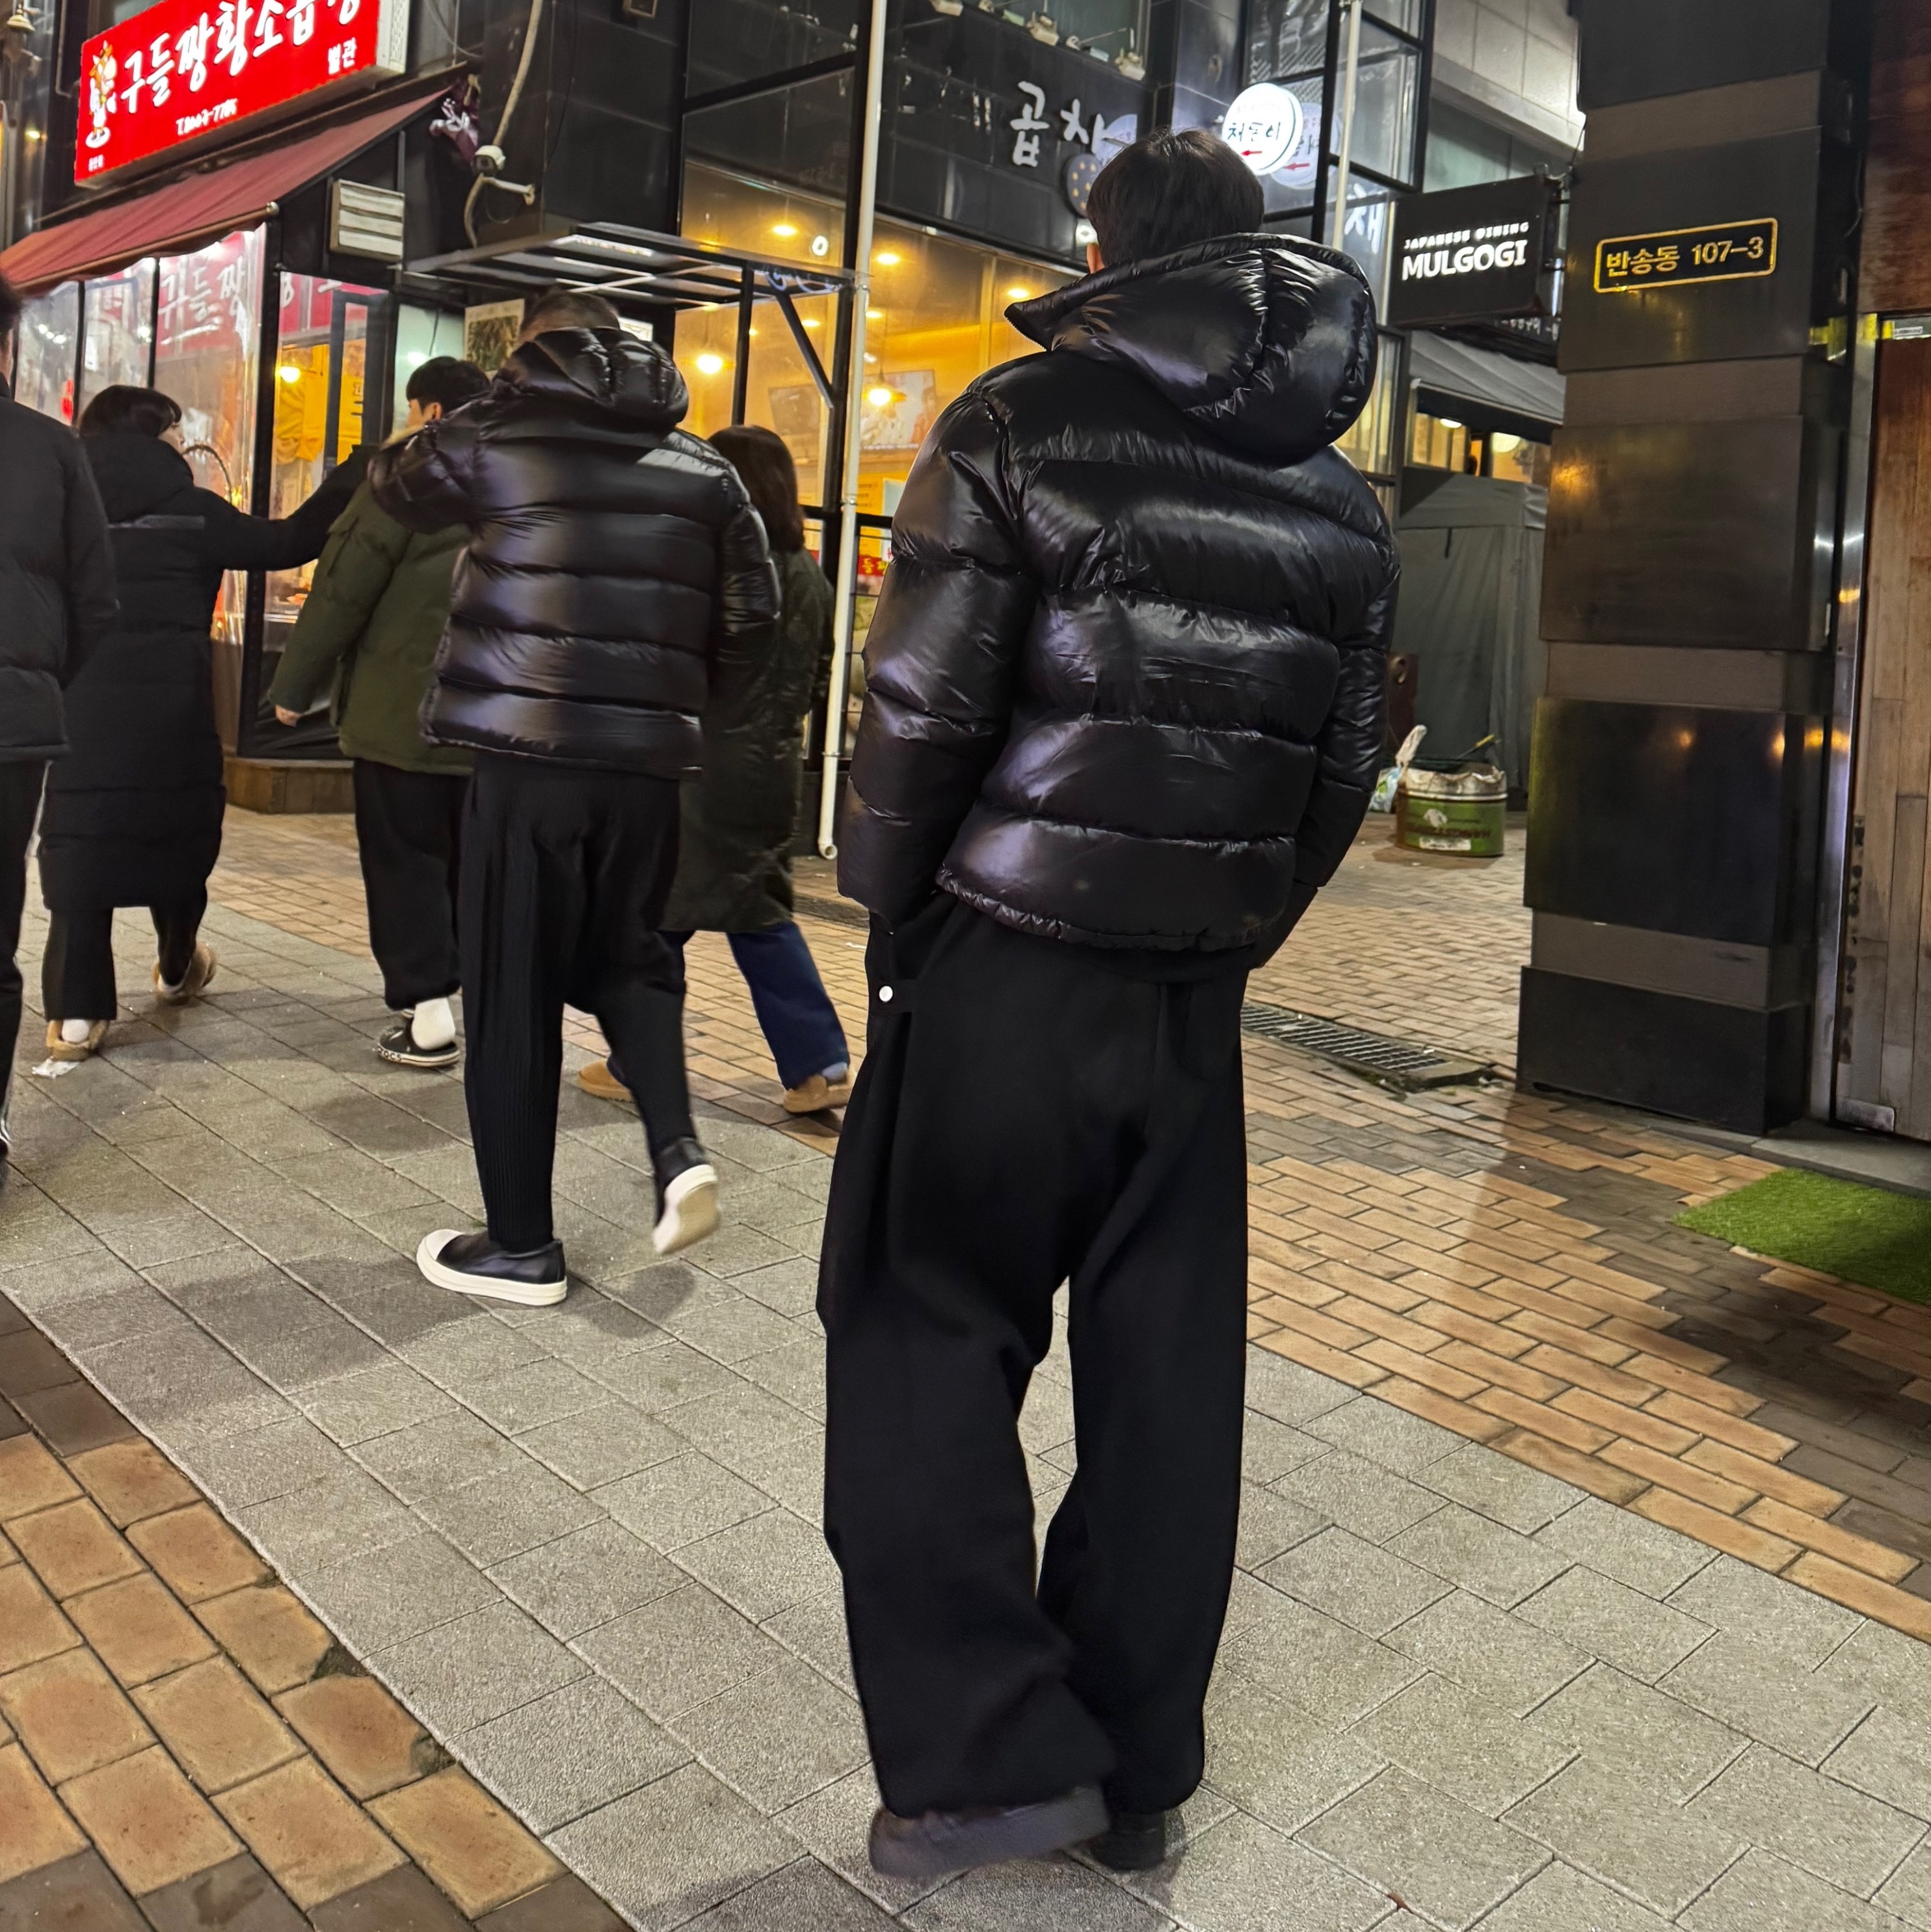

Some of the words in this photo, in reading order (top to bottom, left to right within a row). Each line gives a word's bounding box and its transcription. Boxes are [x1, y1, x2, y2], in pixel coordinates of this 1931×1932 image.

[1404, 230, 1471, 249] JAPANESE
[1475, 222, 1529, 239] DINING
[1402, 239, 1528, 281] MULGOGI
[1606, 245, 1681, 277] 반송동
[1691, 236, 1764, 265] 107-3
